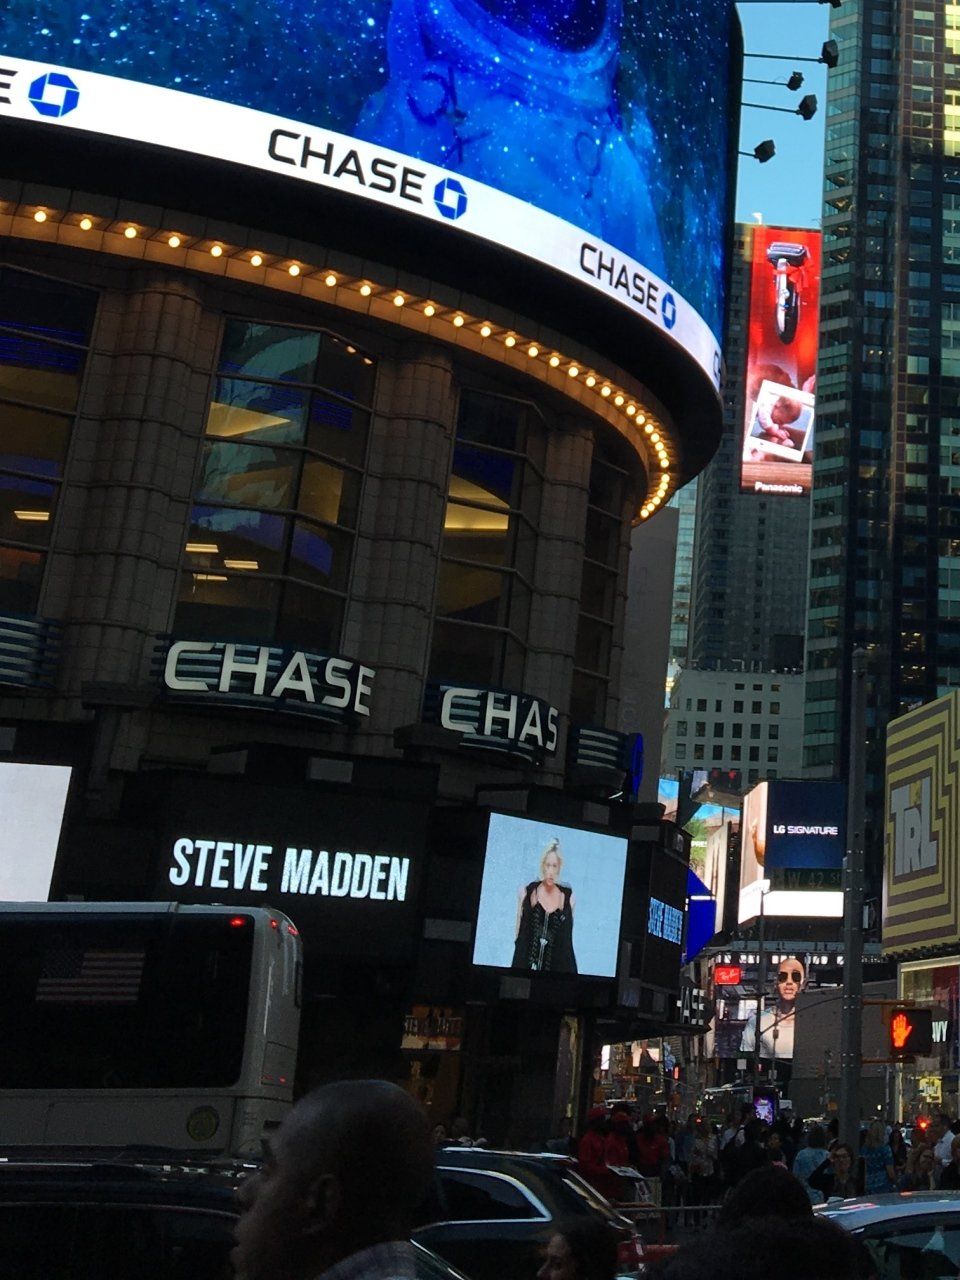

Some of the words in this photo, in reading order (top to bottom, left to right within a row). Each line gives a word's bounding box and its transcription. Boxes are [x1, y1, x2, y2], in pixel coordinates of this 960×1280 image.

[268, 128, 427, 205] CHASE
[580, 242, 659, 315] CHASE
[754, 480, 803, 494] Panasonic
[164, 640, 376, 717] CHASE
[440, 687, 559, 752] CHAS
[773, 824, 786, 834] LG
[787, 825, 839, 835] SIGNATURE
[890, 775, 938, 877] TRL
[168, 837, 273, 891] STEVE
[280, 847, 410, 902] MADDEN
[808, 871, 824, 888] 42
